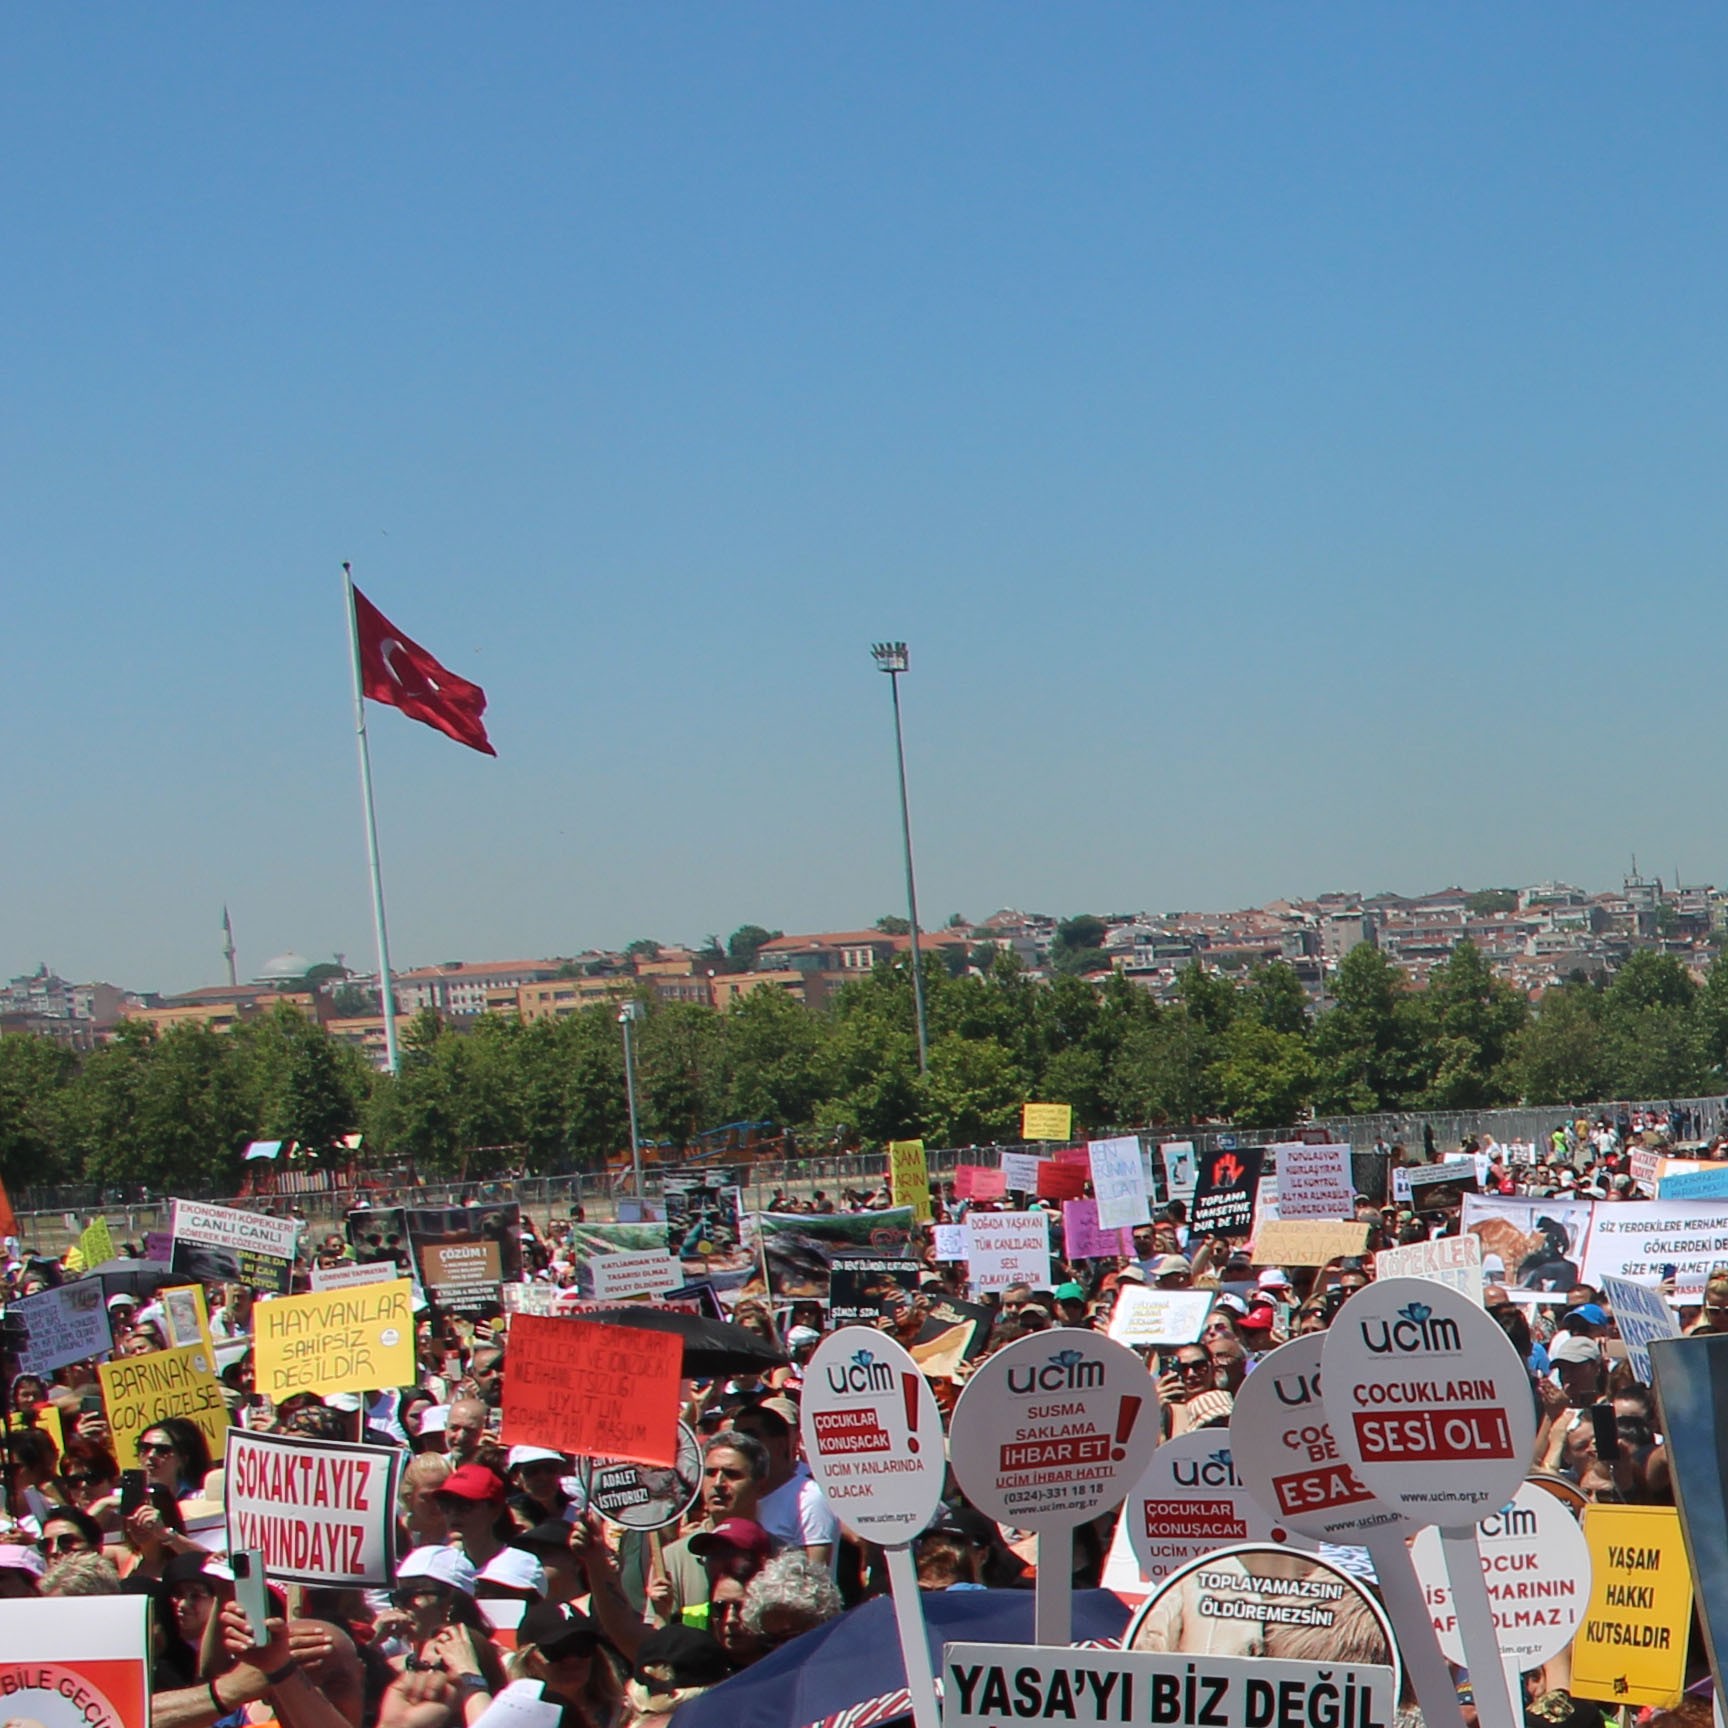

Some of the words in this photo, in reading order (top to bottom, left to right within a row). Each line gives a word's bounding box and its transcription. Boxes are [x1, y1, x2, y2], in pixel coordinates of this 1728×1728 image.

[1200, 1191, 1246, 1207] TOPLAMA
[181, 1204, 237, 1221] EKONOMİYİ
[239, 1214, 294, 1232] KÖPEKLERİ
[192, 1217, 235, 1233] CANLI
[240, 1225, 281, 1242] CANLI
[972, 1216, 1003, 1230] DOĞADA
[1005, 1218, 1043, 1231] YAŞAYAN
[1193, 1219, 1215, 1232] DUR
[1218, 1216, 1232, 1228] DE
[1235, 1214, 1250, 1225] !!!
[1600, 1221, 1615, 1232] SİZ
[1619, 1219, 1681, 1233] YERDEKİLERE
[975, 1237, 992, 1250] TÜM
[1644, 1236, 1712, 1253] GÖKLERDEKİ
[1715, 1239, 1728, 1250] DE
[652, 1256, 671, 1264] YASA
[1621, 1263, 1646, 1275] SİZE
[1651, 1261, 1711, 1274] MEHAMET
[605, 1283, 633, 1293] DEVLET
[635, 1278, 674, 1290] ÖLDÜRMEZ
[607, 1270, 640, 1281] TASARISI
[642, 1267, 668, 1278] OLMAZ
[269, 1293, 409, 1339] HAYVANLAR
[282, 1331, 368, 1361] SAHİPSİZ
[111, 1354, 193, 1401] BARINAK
[274, 1348, 375, 1390] DEĞİLDİR
[1353, 1380, 1497, 1407] ÇOCUKLARIN
[112, 1403, 145, 1437] ÇOK
[153, 1387, 221, 1425] GÜZELSE
[814, 1411, 876, 1430] ÇOCUKLAR
[1027, 1402, 1086, 1420] SUSMA
[818, 1432, 889, 1453] KONUŞACAK
[1015, 1421, 1096, 1441] SAKLAMA
[1361, 1414, 1438, 1452] SESİ
[1445, 1414, 1491, 1449] OL
[1499, 1412, 1509, 1448] !
[1004, 1442, 1076, 1466] İHBAR
[1079, 1440, 1106, 1461] ET
[237, 1445, 373, 1511] SOKAKTAYIZ
[824, 1460, 852, 1476] UCİM
[853, 1458, 925, 1475] YANLARINDA
[602, 1471, 638, 1488] ADALET
[598, 1489, 650, 1510] İSTİYORUZ!
[828, 1484, 874, 1500] OLACAK
[1003, 1486, 1068, 1506] (0324)-331
[1072, 1484, 1086, 1499] 18
[1089, 1482, 1104, 1497] 18
[1008, 1496, 1099, 1518] www.ucim.org.tr
[238, 1512, 366, 1575] YANINDAYIZ
[1608, 1546, 1661, 1575] YAŞAM
[1199, 1572, 1343, 1600] TOPLAYAMAZSIN!
[1606, 1584, 1654, 1609] HAKKI
[1200, 1598, 1334, 1628] ÖLDÜREMEZSİN!
[1586, 1620, 1670, 1650] KUTSALDIR
[1151, 1664, 1229, 1727] BİZ
